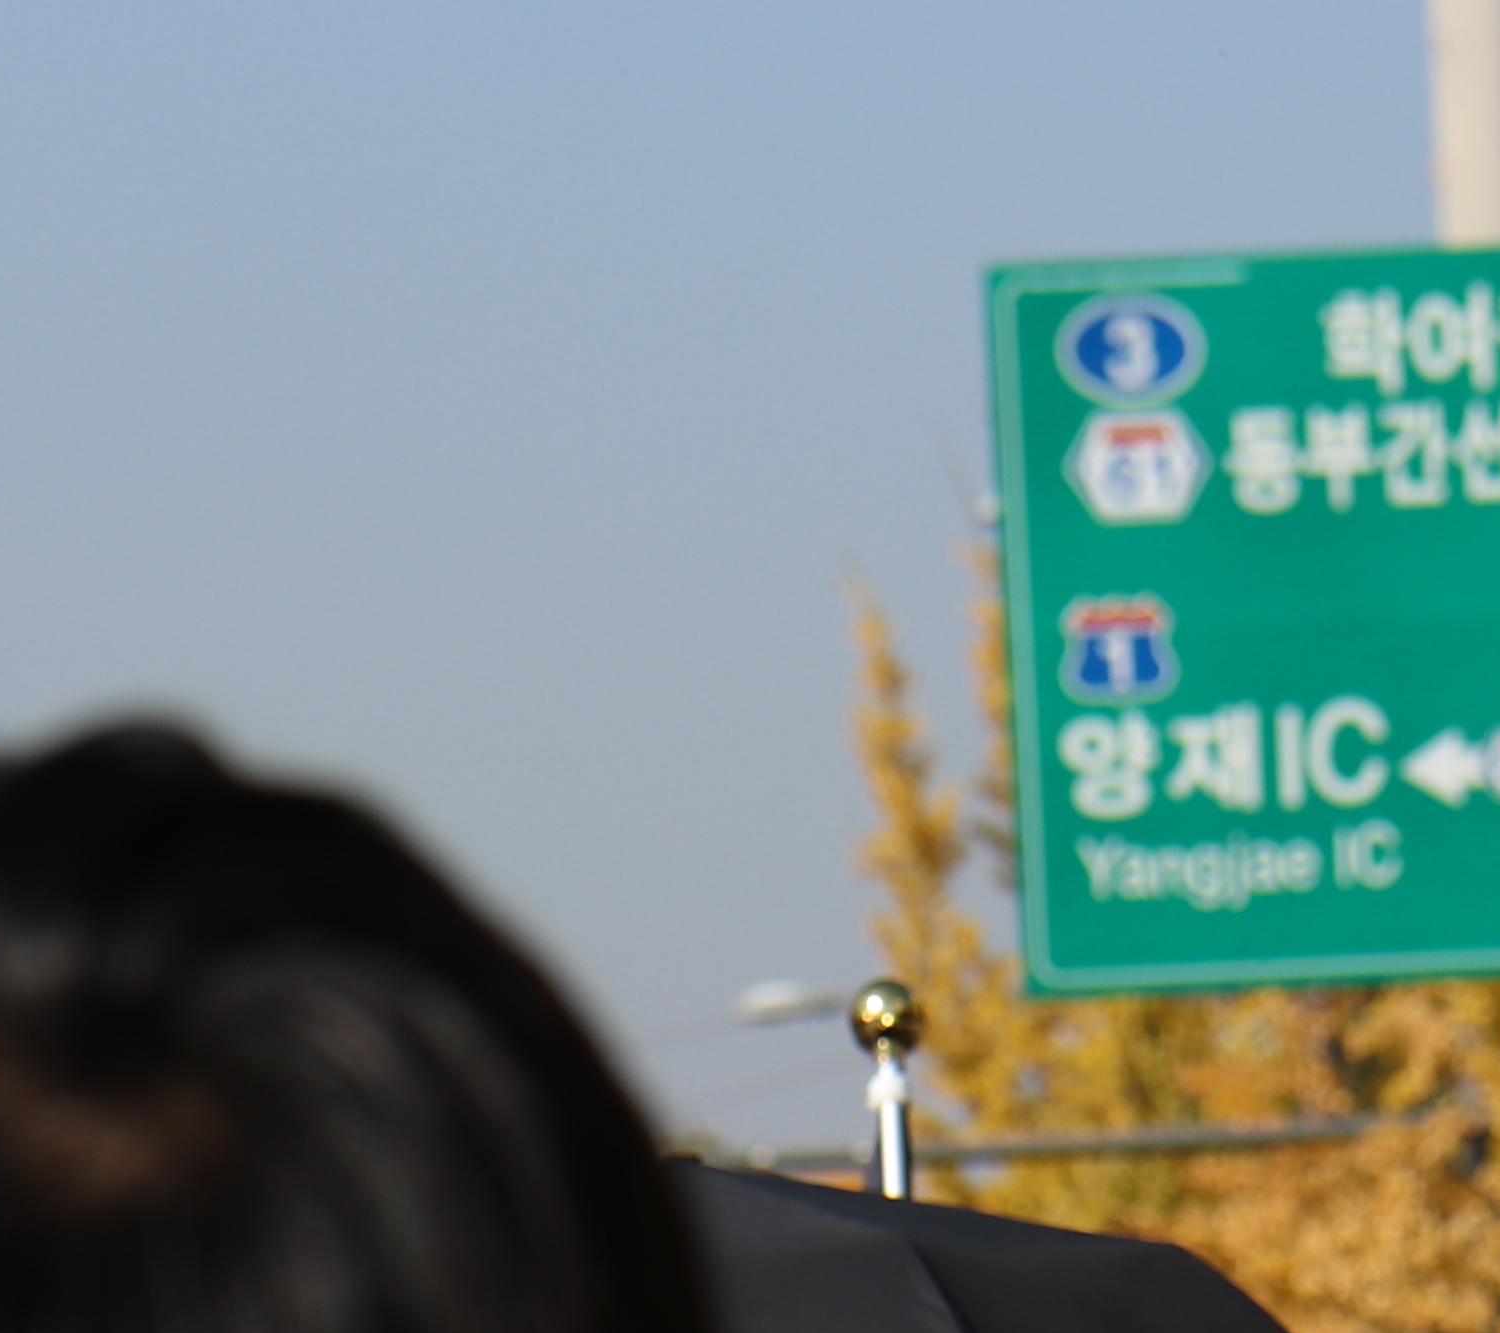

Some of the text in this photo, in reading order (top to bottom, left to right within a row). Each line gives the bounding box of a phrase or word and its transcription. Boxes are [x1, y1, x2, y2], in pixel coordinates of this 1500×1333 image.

[1102, 312, 1160, 394] 3
[1073, 817, 1405, 912] Yangjae IC
